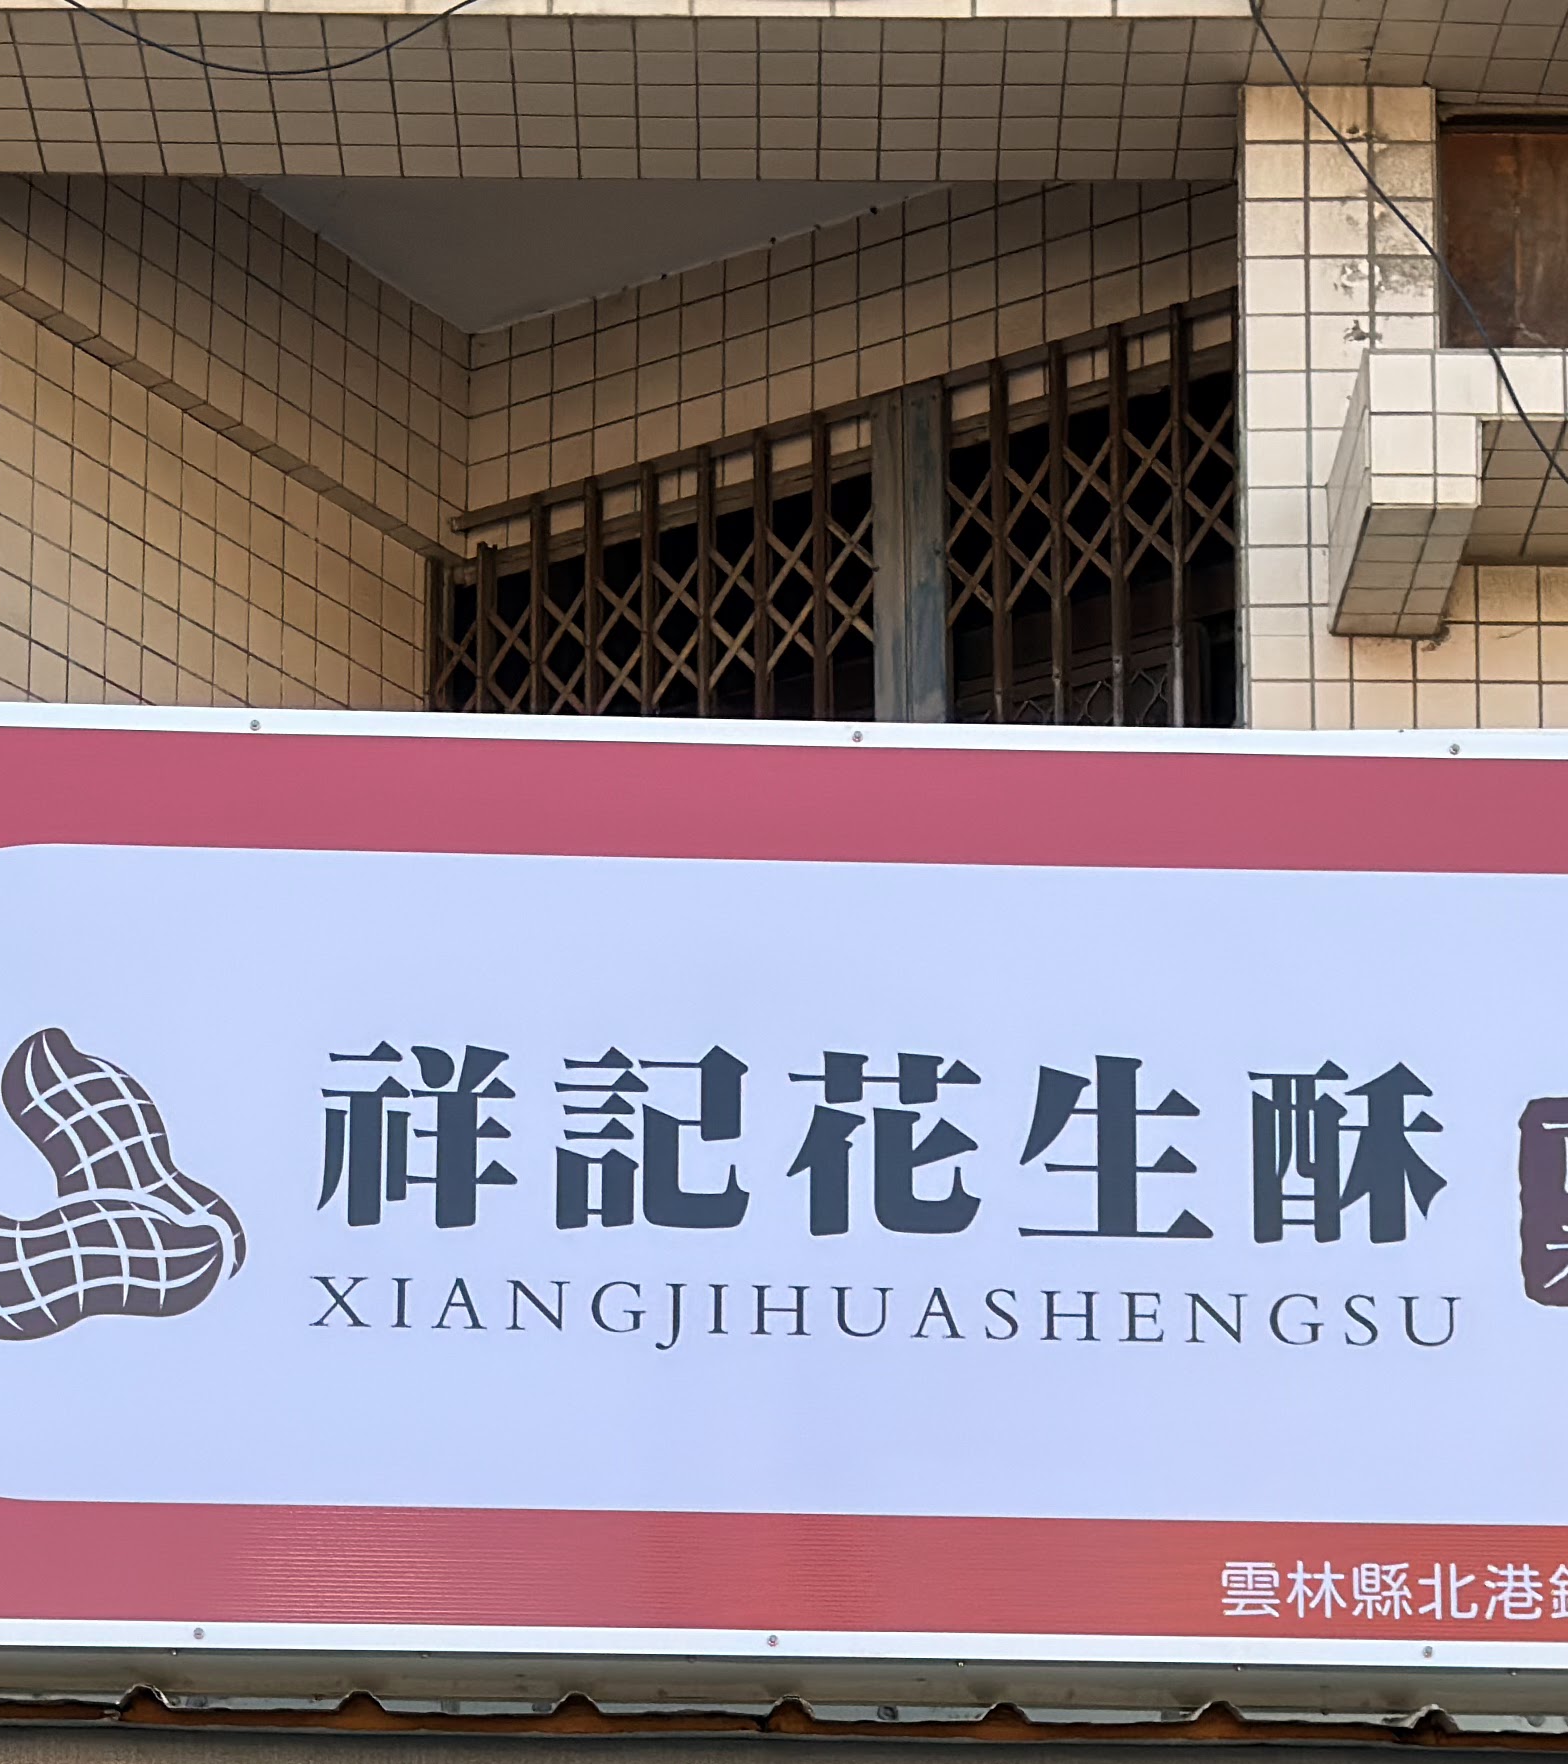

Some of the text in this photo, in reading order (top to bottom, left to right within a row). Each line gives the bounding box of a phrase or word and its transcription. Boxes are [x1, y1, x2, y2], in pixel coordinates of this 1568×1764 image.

[316, 1039, 1449, 1246] 祥記花生酥
[309, 1275, 1465, 1352] XIANGJIHUASHENGSU
